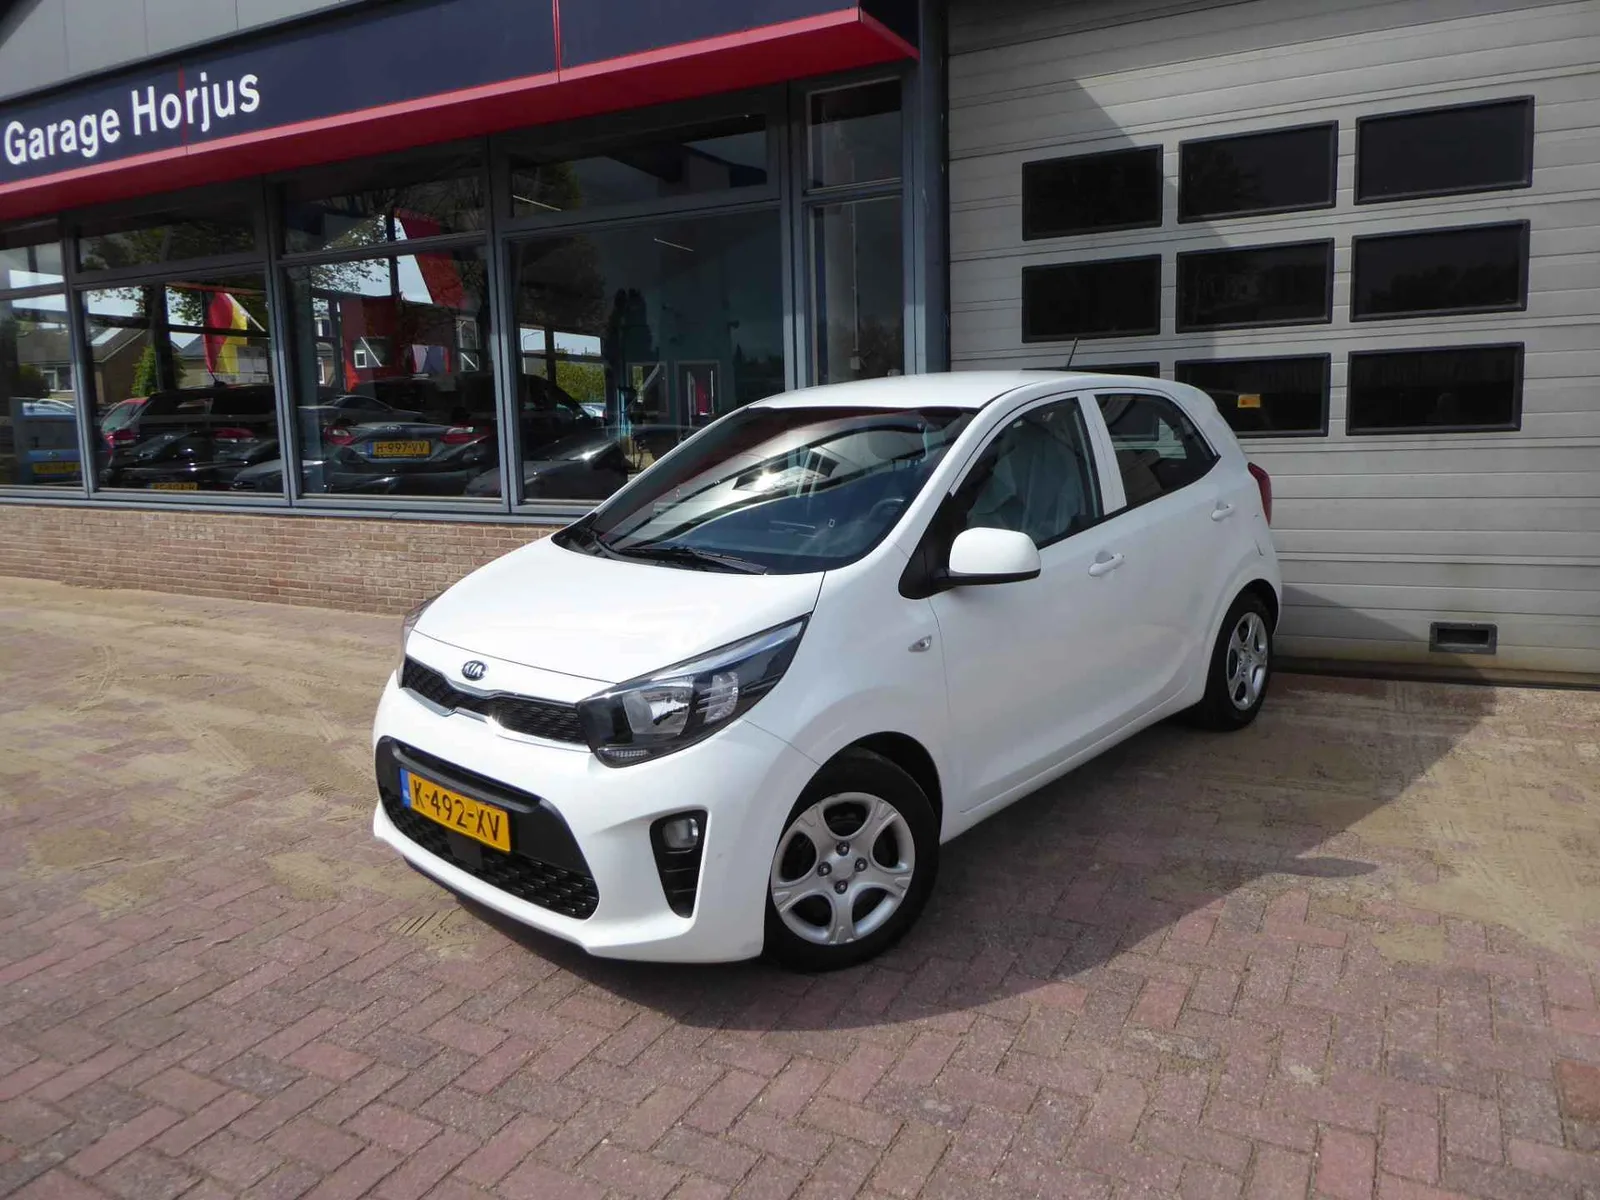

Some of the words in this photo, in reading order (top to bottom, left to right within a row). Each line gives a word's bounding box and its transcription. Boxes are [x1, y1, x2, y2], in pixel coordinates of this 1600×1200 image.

[4, 108, 121, 165] Garage
[131, 72, 260, 135] Horjus
[413, 779, 501, 842] K-492-XV
